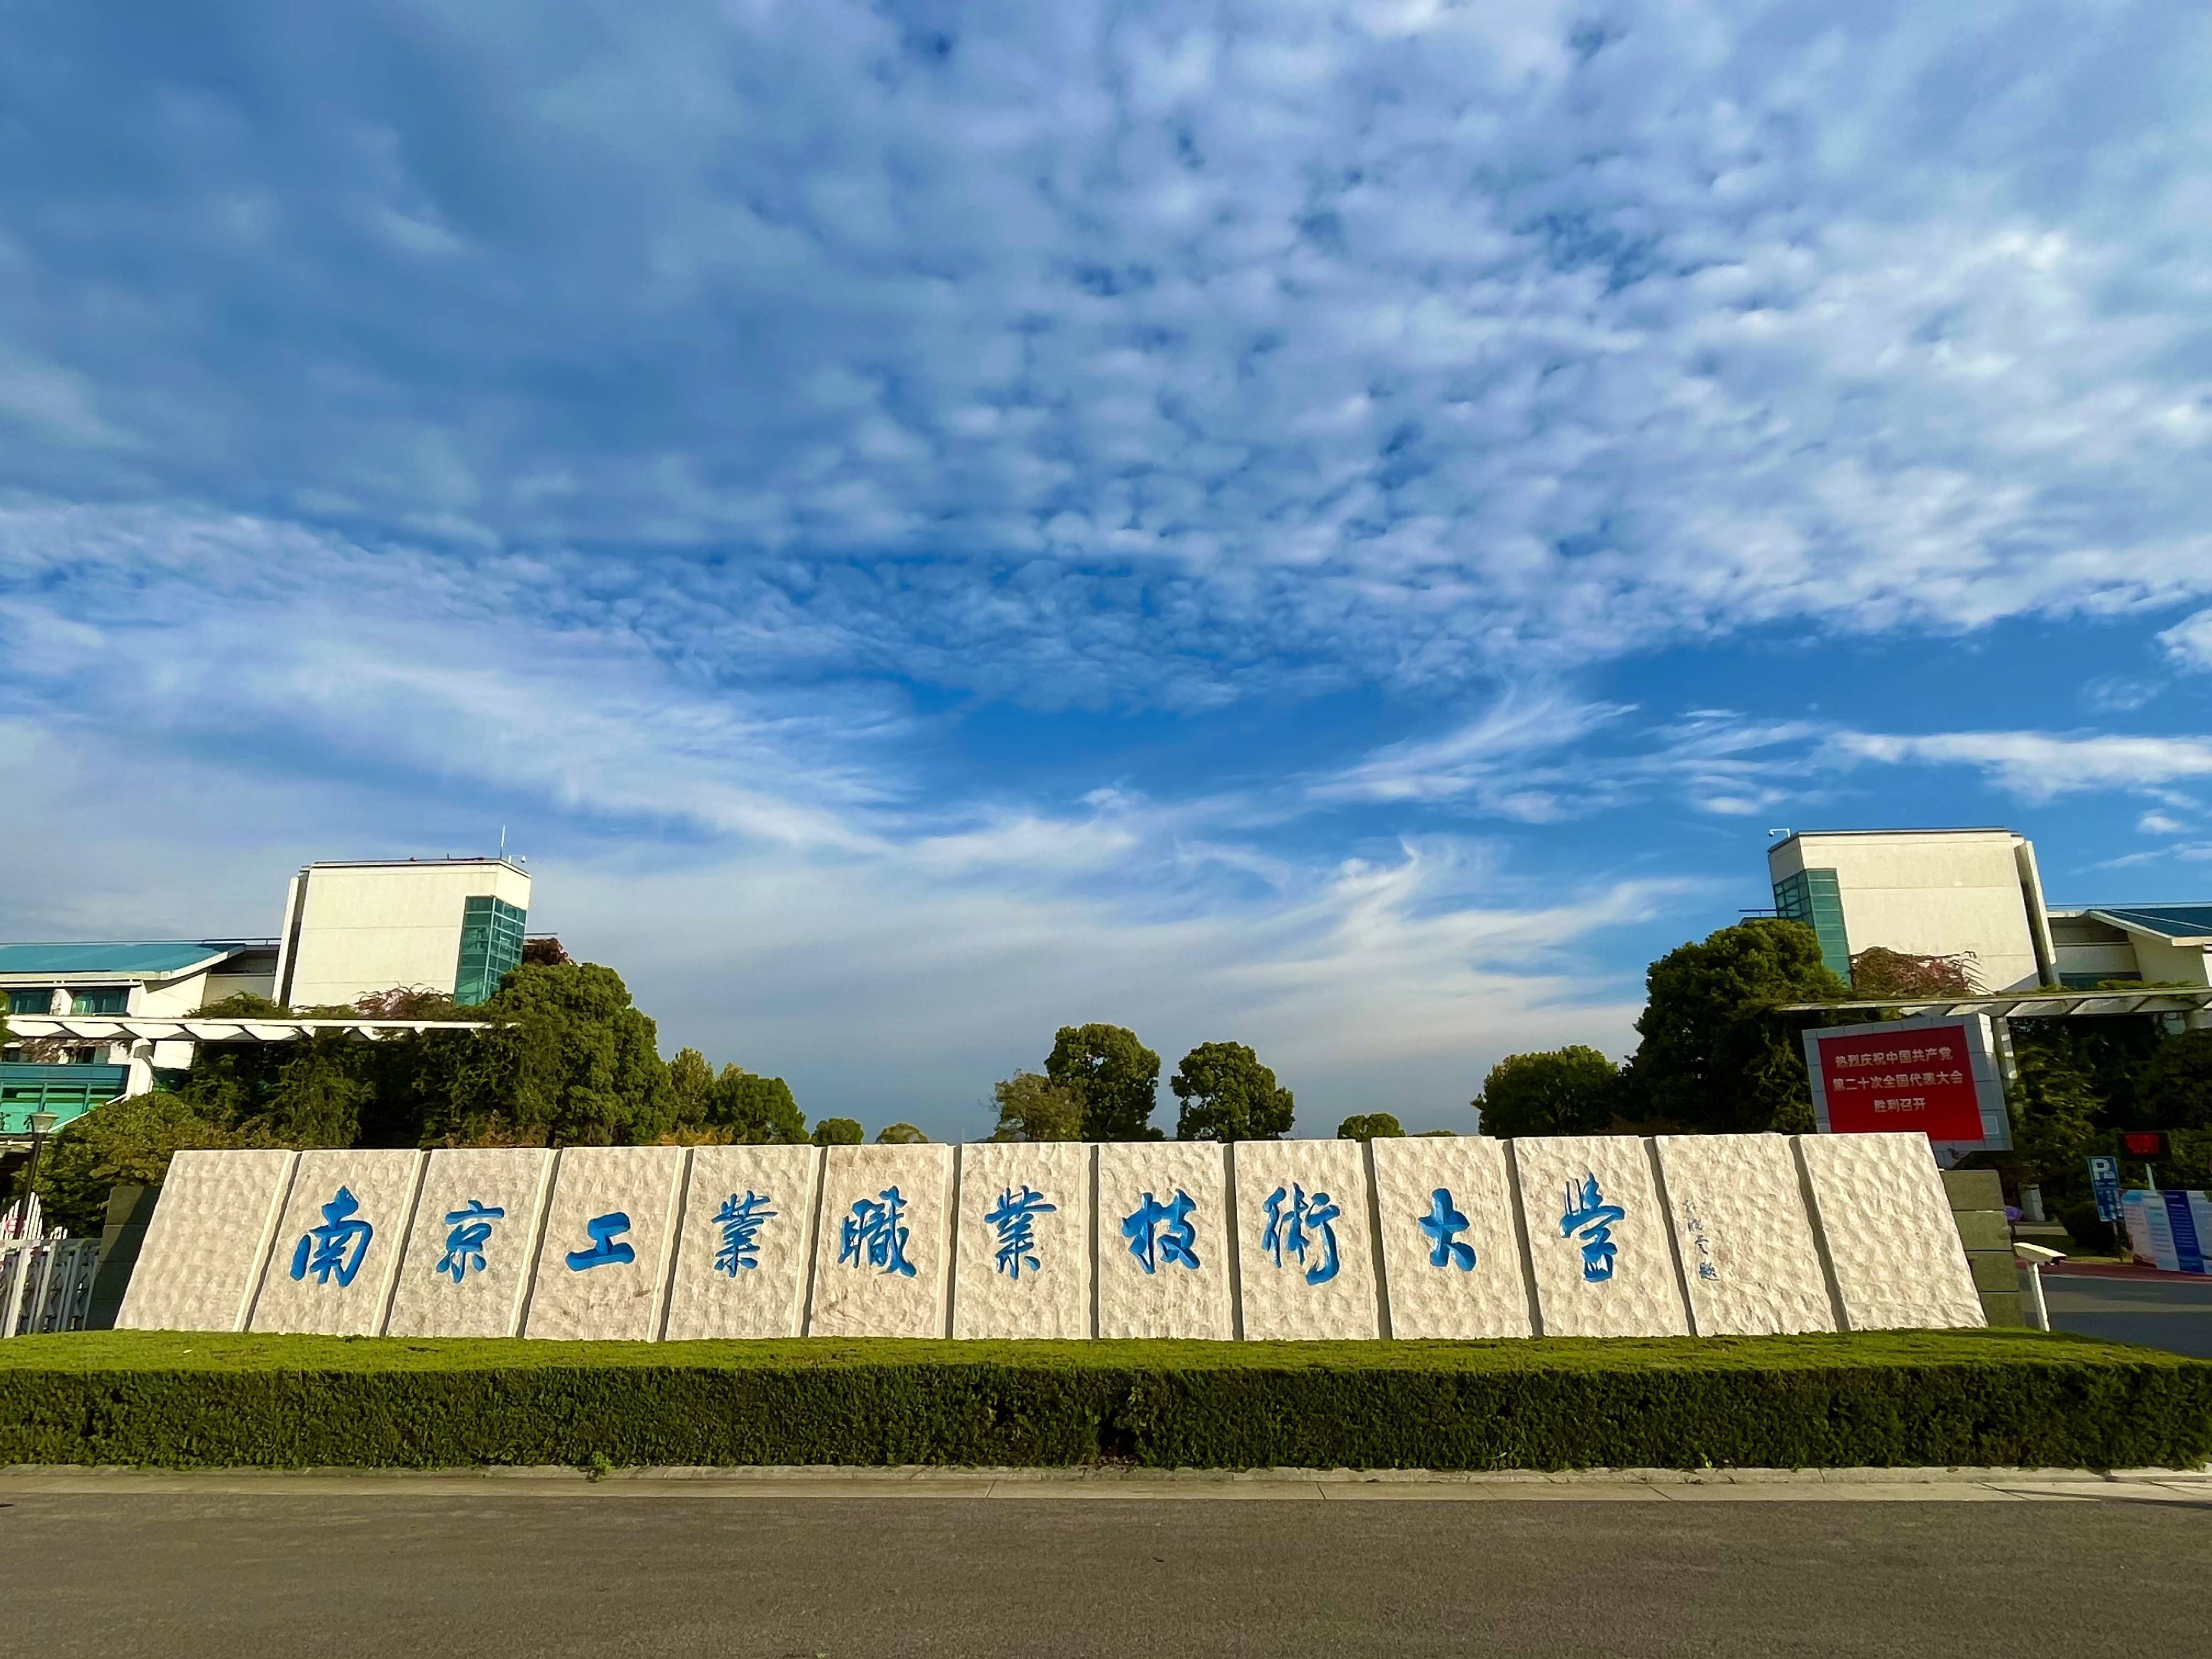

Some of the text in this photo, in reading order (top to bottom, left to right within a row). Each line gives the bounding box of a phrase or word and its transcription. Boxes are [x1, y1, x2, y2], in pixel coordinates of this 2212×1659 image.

[1835, 1047, 1953, 1068] 热烈庆祝中国共产党
[1832, 1070, 1963, 1092] 第二十次全国代表大会
[1874, 1097, 1926, 1113] 胜利召开
[2091, 1159, 2110, 1180] P
